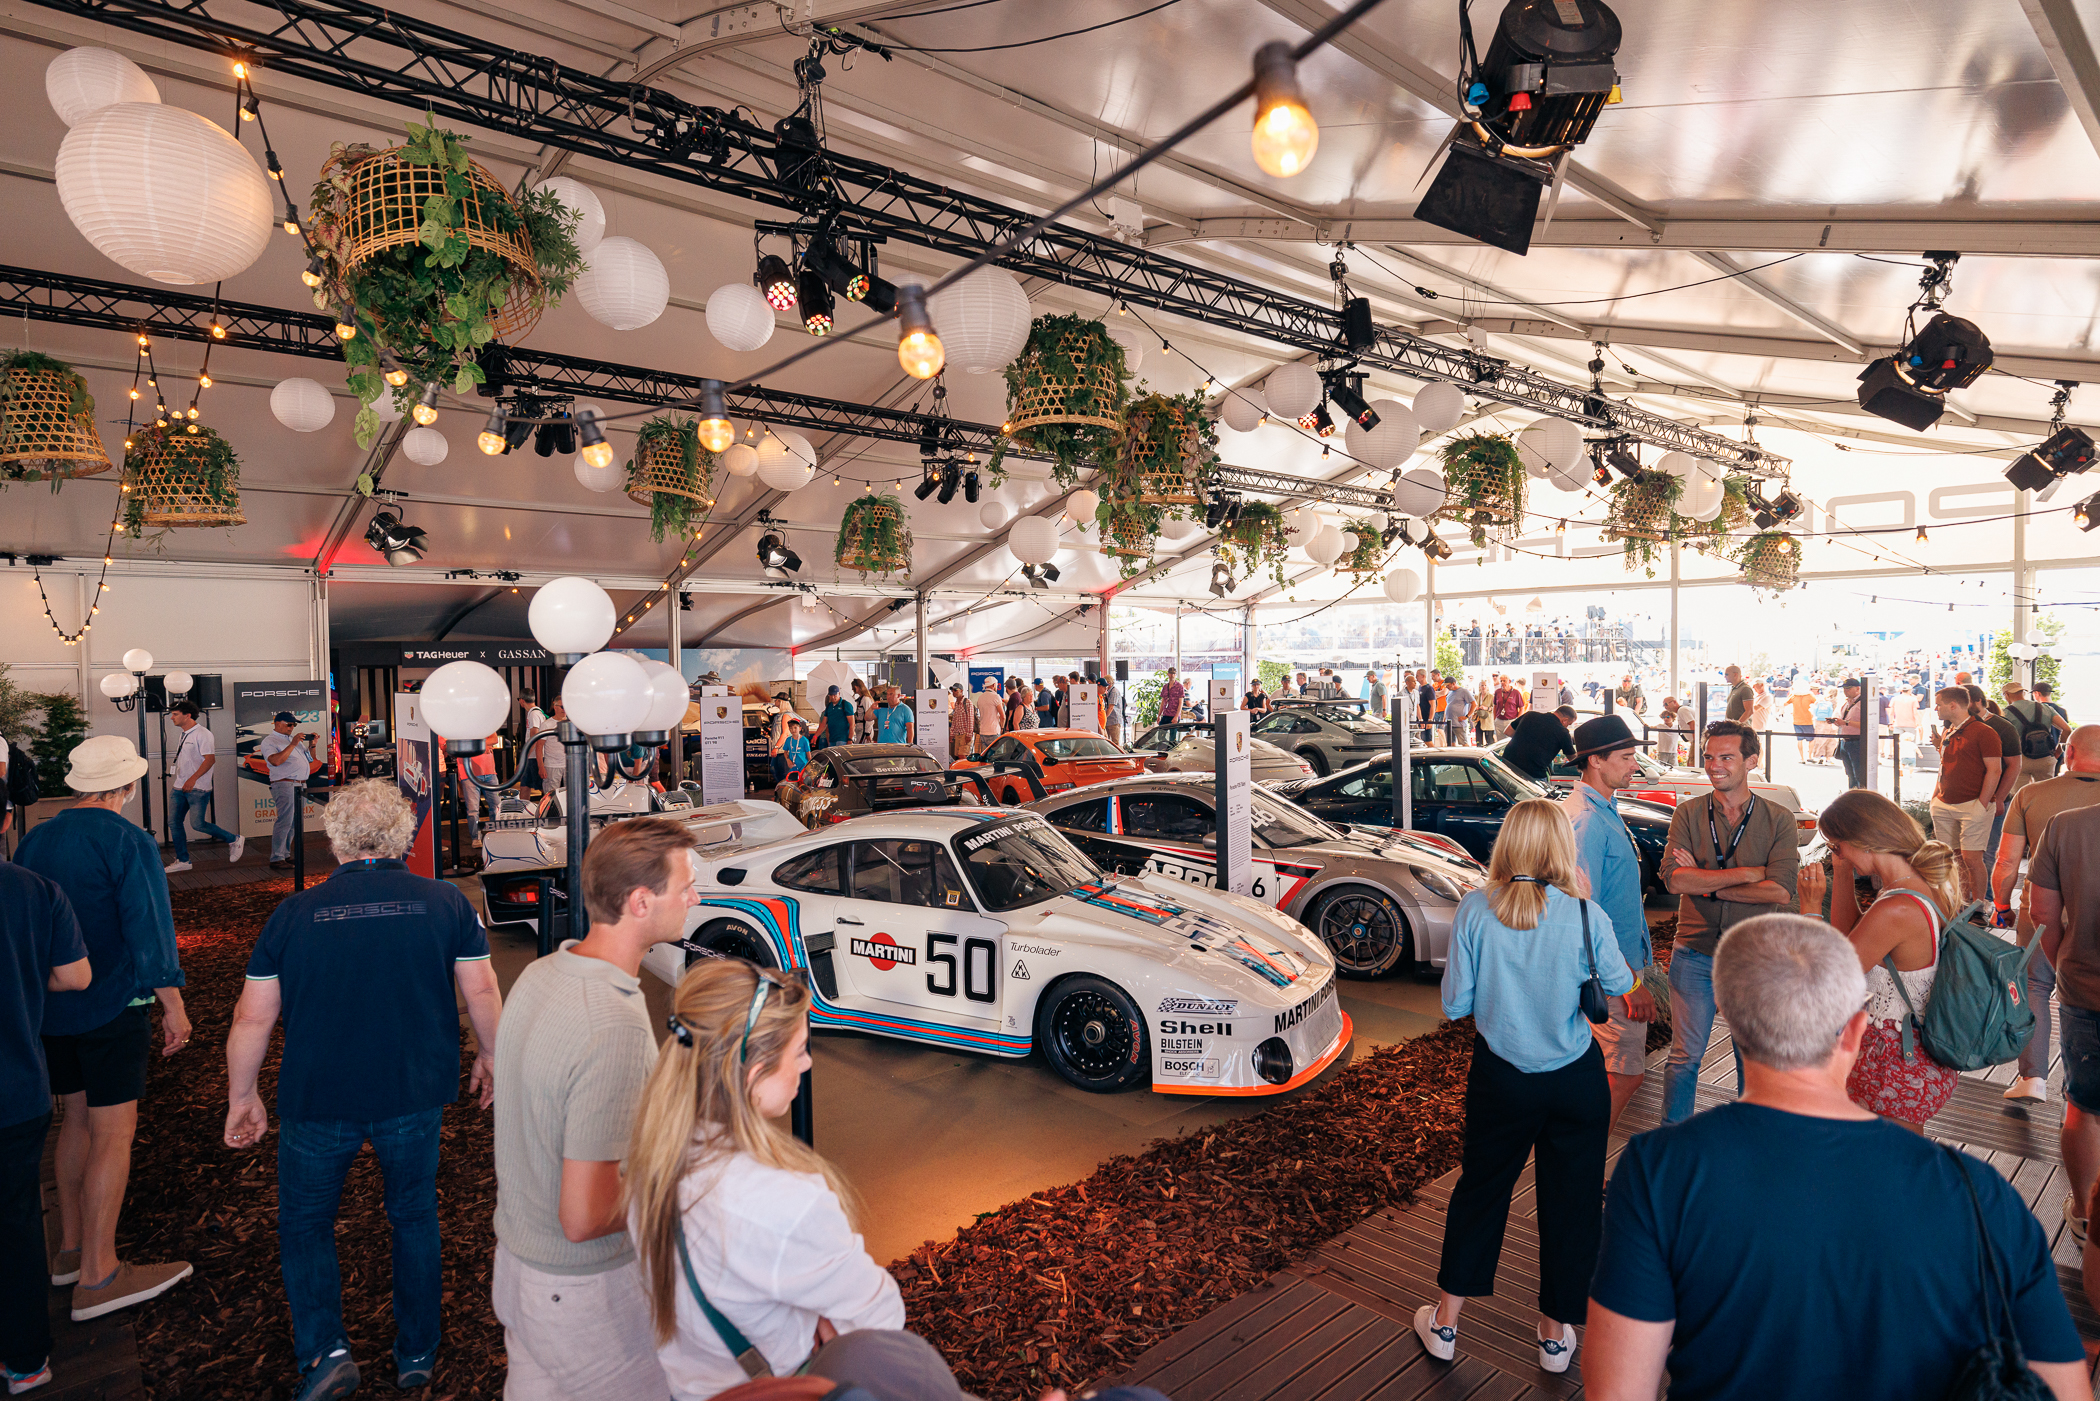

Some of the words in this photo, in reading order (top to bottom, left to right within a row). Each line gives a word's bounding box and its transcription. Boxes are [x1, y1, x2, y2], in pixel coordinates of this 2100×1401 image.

[498, 650, 546, 659] GASSAN
[241, 689, 320, 698] PORSCHE
[1229, 754, 1249, 763] PORSCHE
[484, 817, 550, 831] BILSTEIN
[963, 826, 1014, 851] MARTINI
[314, 903, 427, 921] PORSCHE
[726, 924, 750, 936] AVON
[1391, 909, 1404, 945] MICHELIN
[683, 940, 726, 961] PORSCHE
[853, 940, 914, 963] MARTINI
[1010, 941, 1062, 957] Turbolader
[925, 930, 997, 1005] 50
[1176, 1001, 1235, 1011] DUNLOP
[1274, 990, 1320, 1035] MARTINI
[1160, 1020, 1232, 1036] Shell
[1129, 1018, 1141, 1065] AVON
[1161, 1038, 1203, 1049] BILSTEIN
[1164, 1060, 1205, 1072] BOSCH
